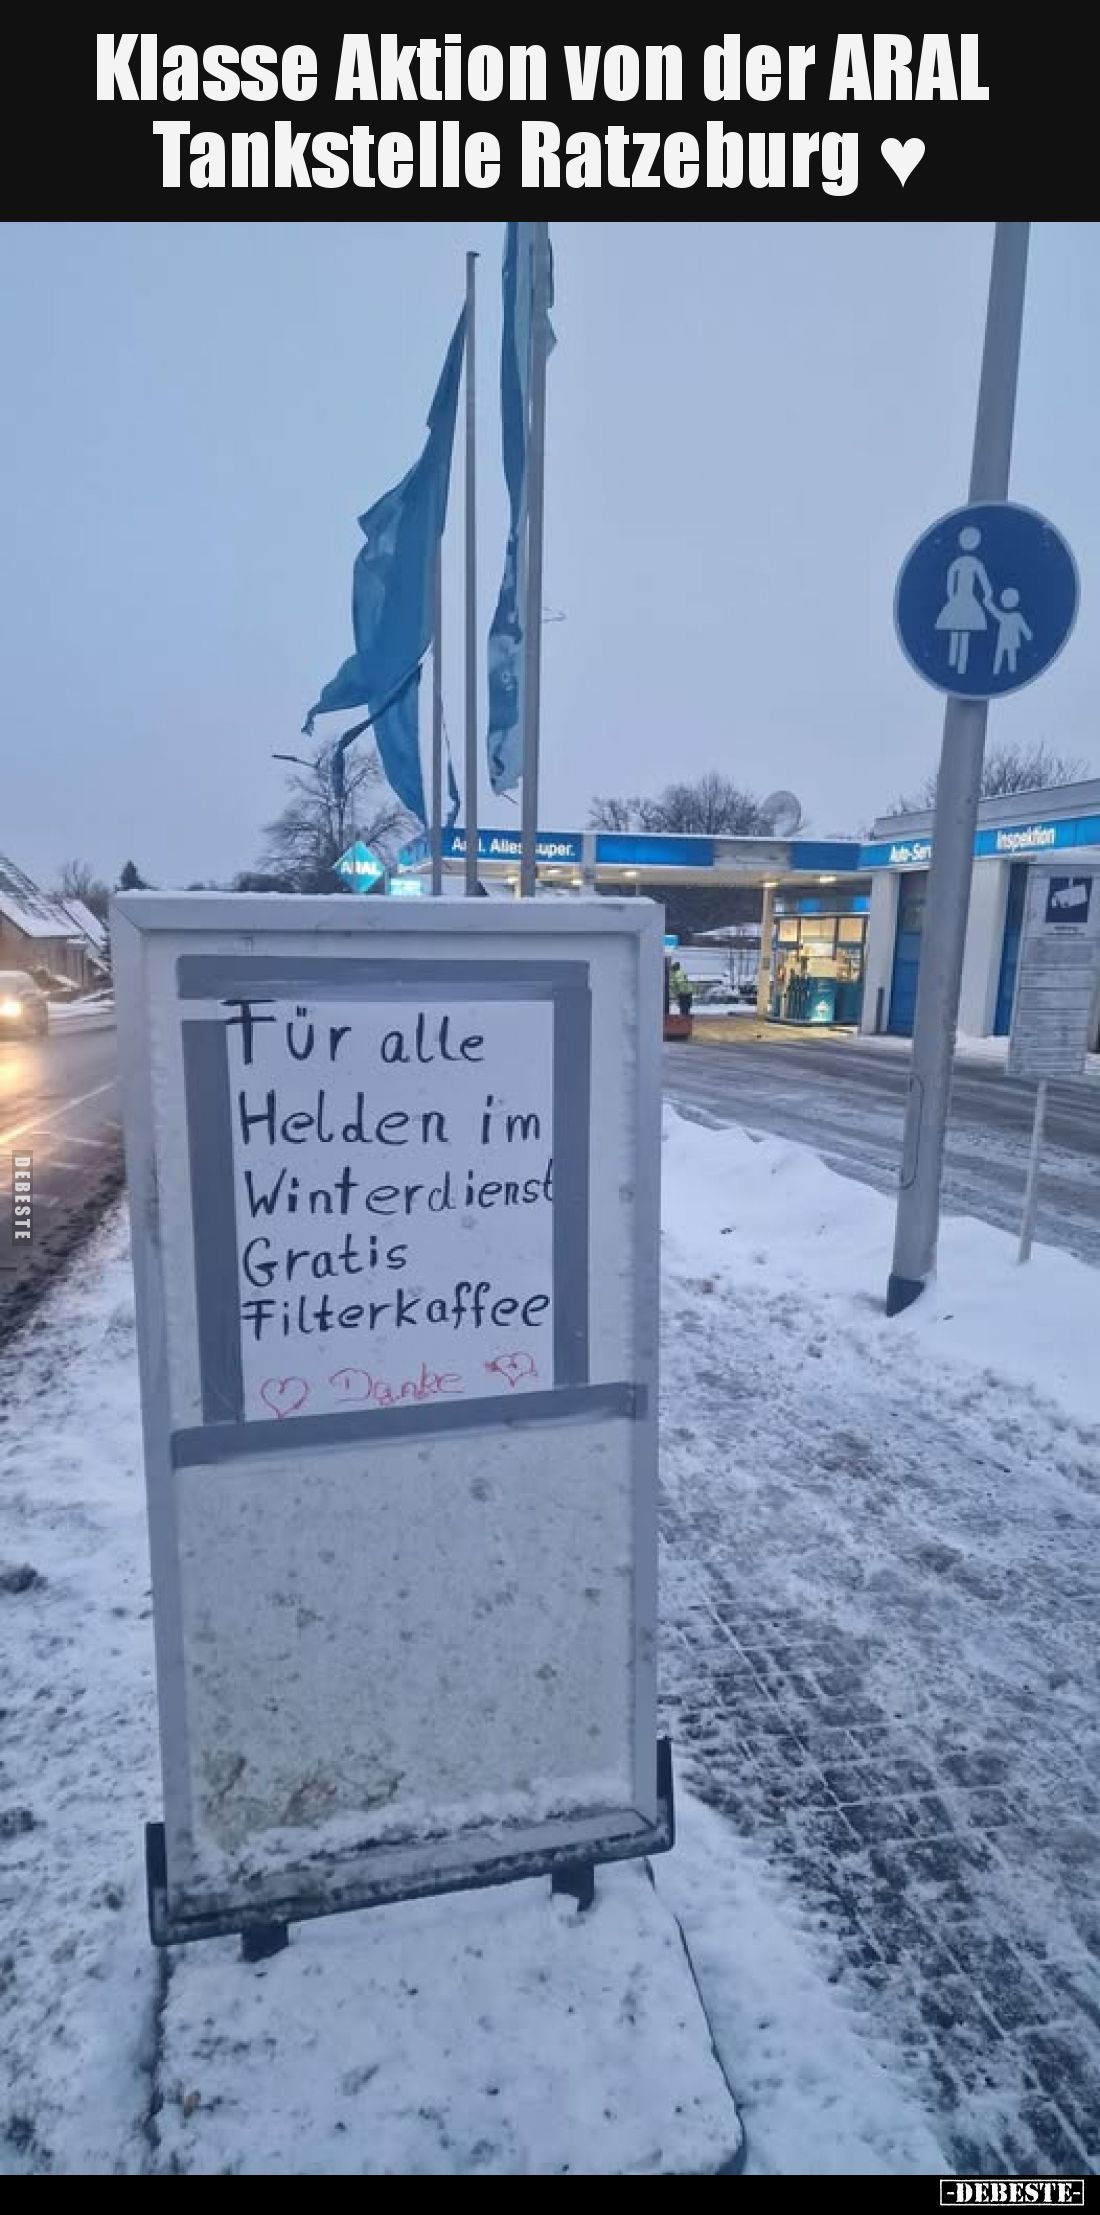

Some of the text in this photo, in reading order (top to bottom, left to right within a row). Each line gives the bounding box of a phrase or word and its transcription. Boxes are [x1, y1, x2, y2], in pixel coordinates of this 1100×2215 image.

[997, 826, 1055, 852] Inspektion
[221, 999, 486, 1065] Für alle
[238, 1089, 541, 1145] Helden im
[244, 1158, 554, 1218] Winterdienst
[242, 1233, 408, 1287] Gratis
[241, 1281, 550, 1341] Filterkaffee
[329, 1362, 465, 1406] Danke
